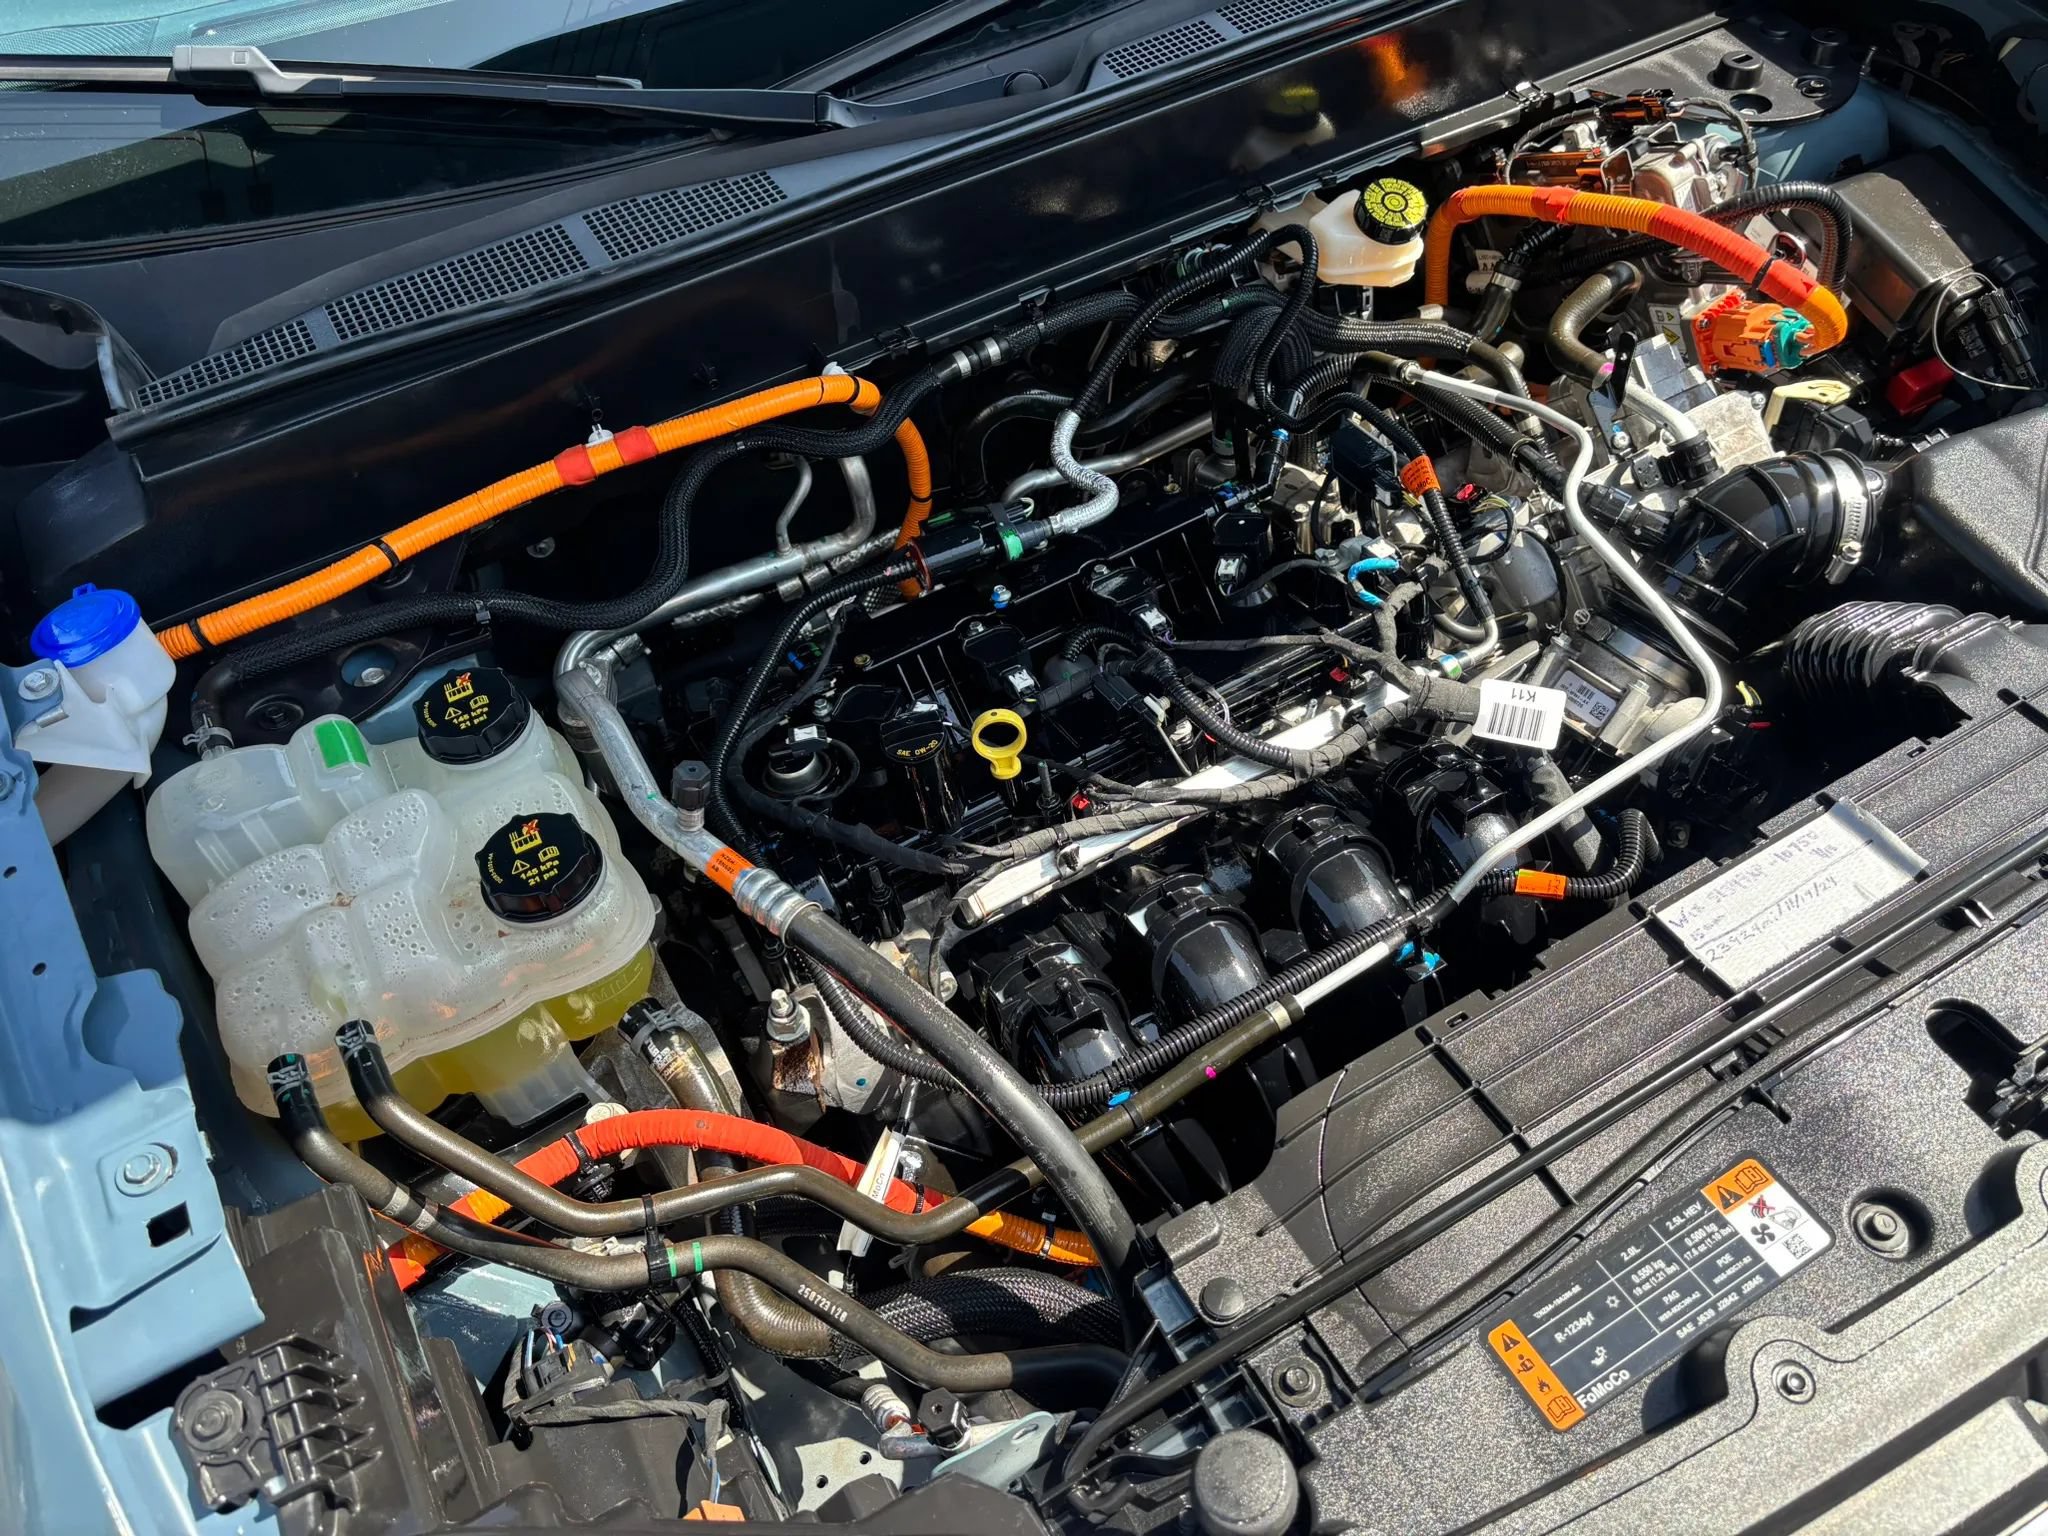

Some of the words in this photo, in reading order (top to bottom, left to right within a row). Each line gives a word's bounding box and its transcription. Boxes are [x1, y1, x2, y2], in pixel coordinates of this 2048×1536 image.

[1511, 687, 1537, 703] K11
[519, 867, 538, 879] 145
[539, 859, 559, 871] kPa
[527, 875, 540, 886] 21
[542, 867, 558, 880] psi
[1665, 1213, 1685, 1230] 2.5L
[1682, 1201, 1702, 1218] HEV
[1703, 1221, 1719, 1233] kg
[1620, 1243, 1641, 1261] 2.0L
[1715, 1252, 1734, 1267] POE
[1630, 1264, 1653, 1283] 0.550
[1650, 1258, 1666, 1270] kg
[1662, 1289, 1680, 1304] PAG
[1553, 1310, 1595, 1342] R-1234yf
[1675, 1321, 1696, 1338] SAE
[1575, 1367, 1631, 1409] FoMoCo
